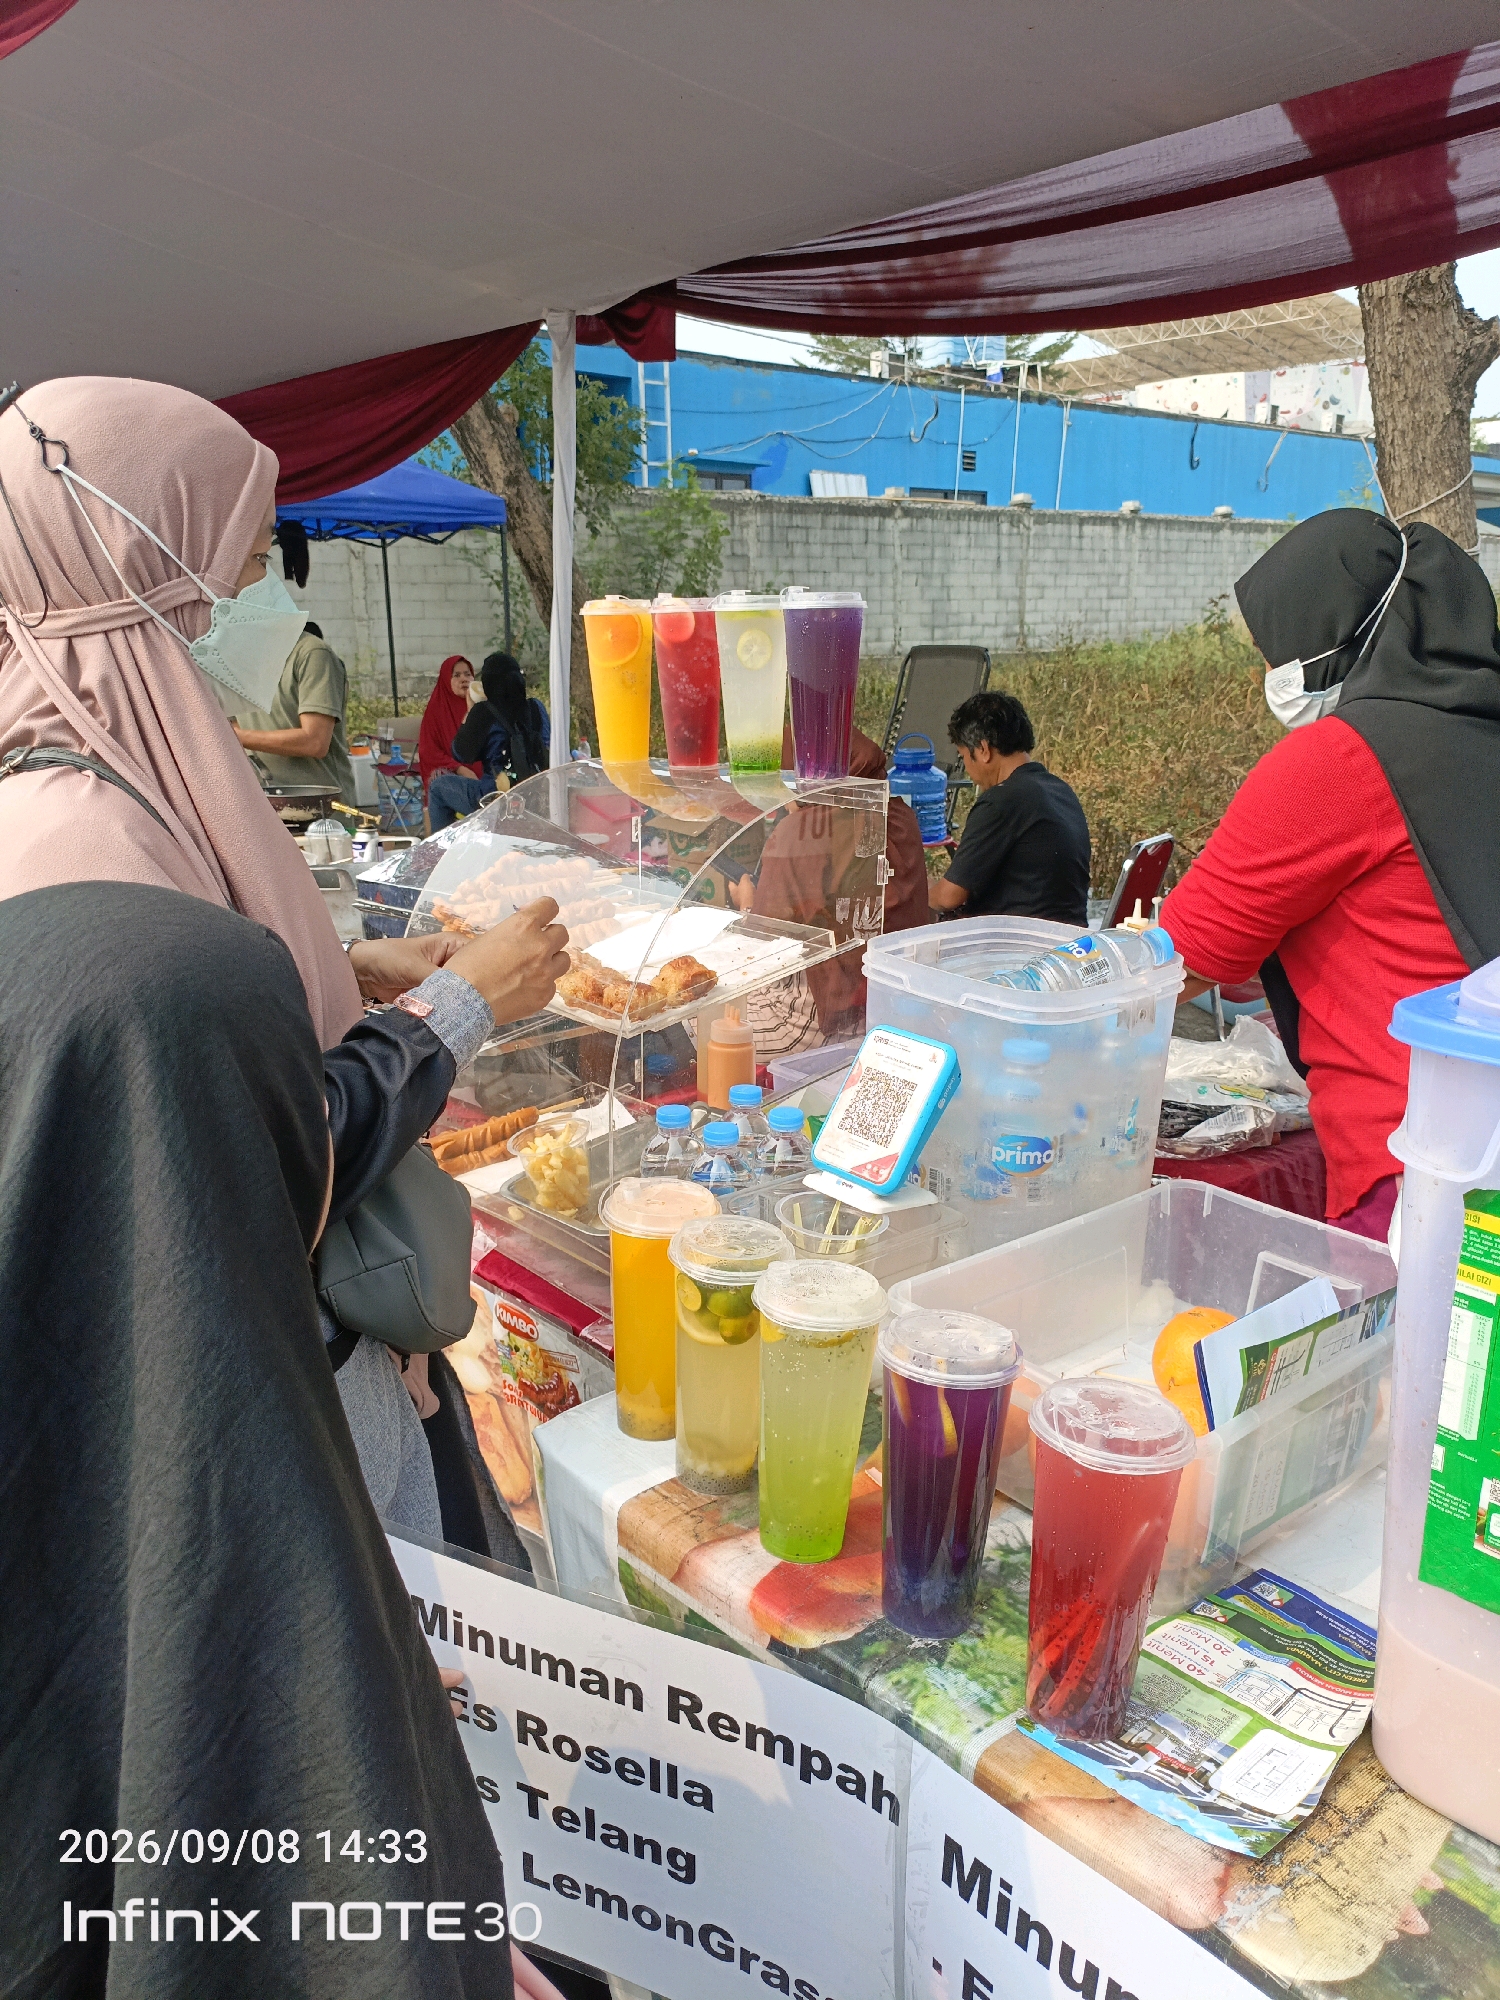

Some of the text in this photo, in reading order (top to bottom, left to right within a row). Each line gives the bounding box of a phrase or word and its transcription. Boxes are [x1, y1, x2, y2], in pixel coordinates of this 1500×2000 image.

[496, 1303, 537, 1339] KIMBO
[1161, 1632, 1200, 1655] Menit
[1173, 1624, 1211, 1643] Menit
[1146, 1640, 1184, 1664] Menit
[1201, 1654, 1215, 1666] 15
[1213, 1643, 1231, 1656] 20
[1186, 1663, 1206, 1677] 40
[411, 1595, 900, 1826] Minuman Rempah
[516, 1709, 715, 1813] Rosella
[516, 1781, 696, 1885] Telang
[522, 1851, 834, 2000] LemonGras
